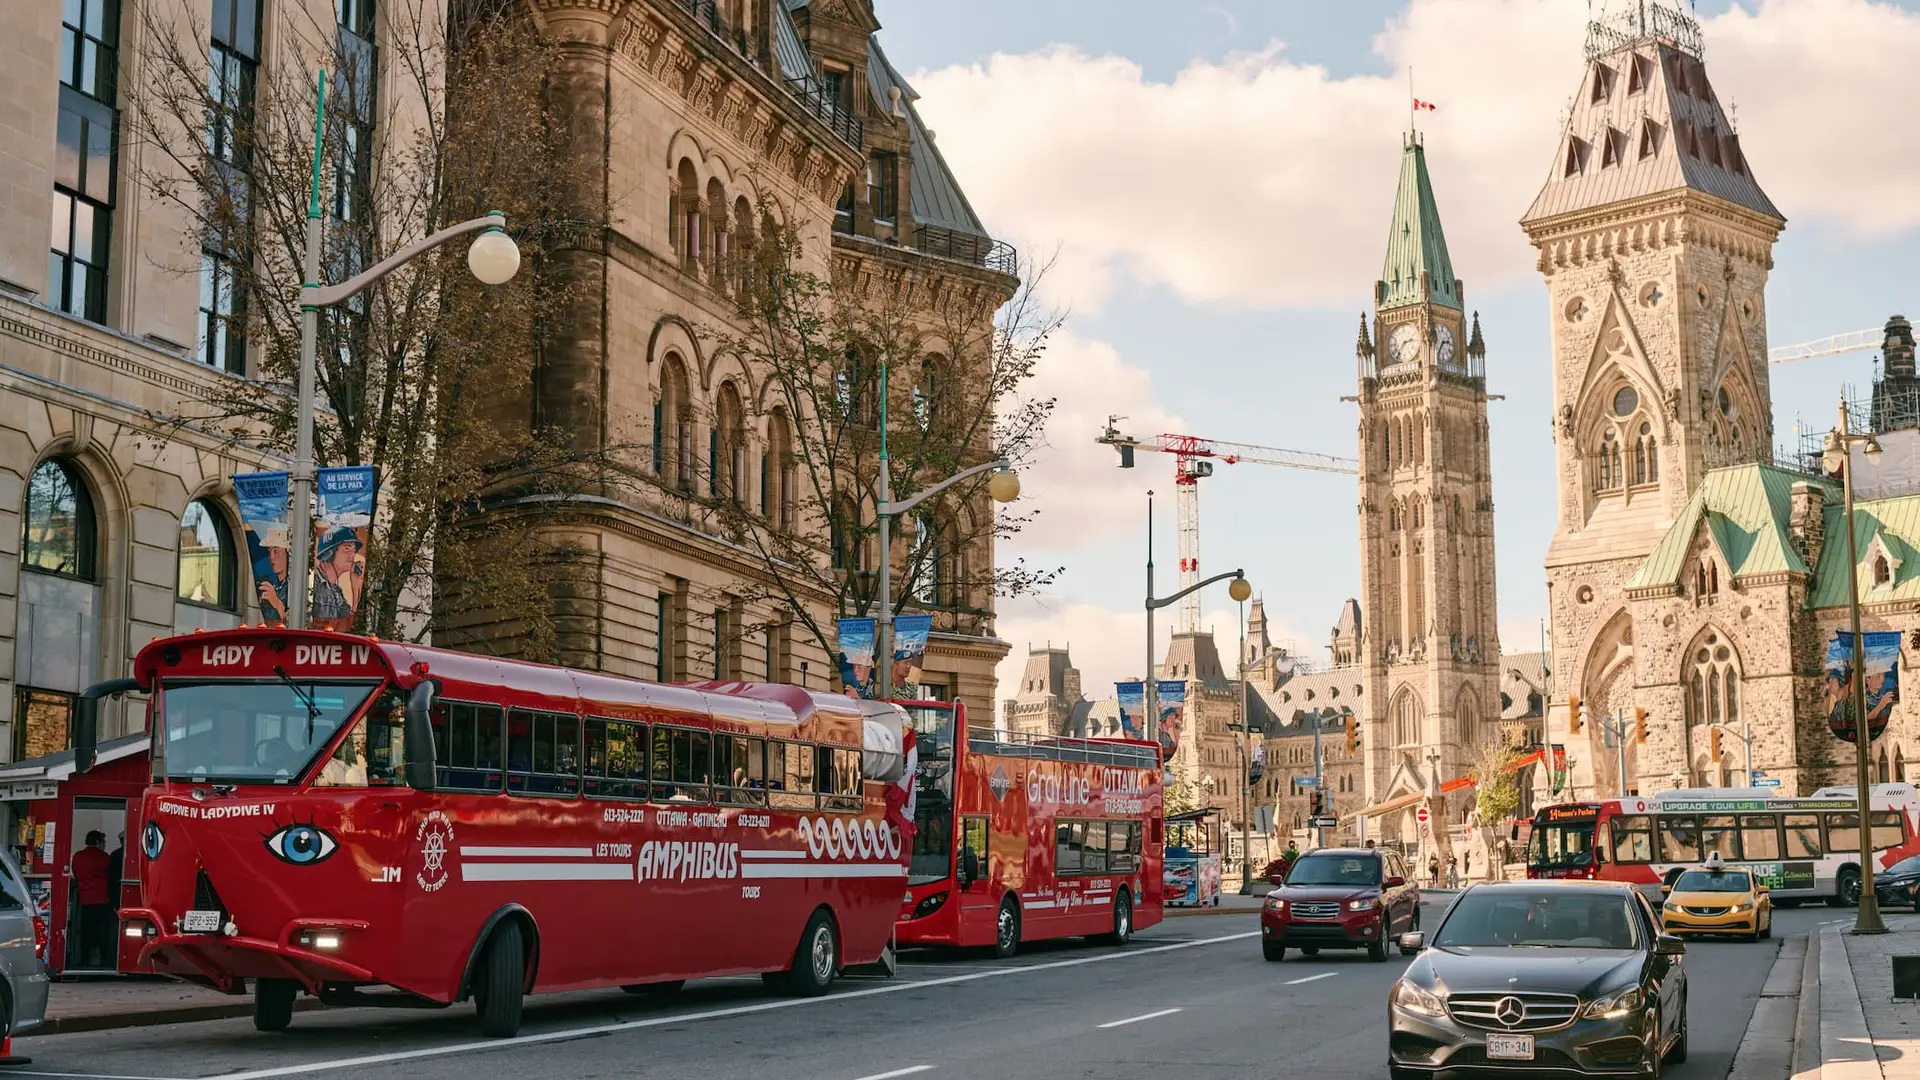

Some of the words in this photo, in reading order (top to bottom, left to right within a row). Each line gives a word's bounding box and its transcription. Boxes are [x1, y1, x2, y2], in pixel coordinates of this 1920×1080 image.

[327, 474, 336, 482] AU
[337, 473, 363, 481] SERVICE
[327, 482, 337, 490] DE
[339, 482, 347, 490] LA
[348, 481, 363, 489] PAIX
[202, 645, 254, 667] LADY
[295, 645, 342, 665] DIVE
[350, 645, 370, 665] IV
[1104, 768, 1143, 794] OTTAWA
[160, 801, 190, 818] LADYDIVE
[190, 807, 198, 818] IV
[201, 804, 260, 819] LADYDIVE
[263, 804, 275, 815] IV
[1549, 808, 1557, 820] 14
[1664, 802, 1708, 811] UPGRADE
[1709, 802, 1736, 810] YOUR
[1737, 802, 1758, 810] LIFE!
[416, 816, 429, 841] LAND
[428, 810, 441, 821] AND
[440, 812, 454, 841] WATER
[656, 811, 687, 827] OTTAWA
[693, 812, 727, 828] GATINEAU
[596, 843, 609, 857] LES
[610, 844, 632, 858] TOURS
[638, 841, 739, 884] AMPHIBUS
[416, 872, 427, 889] EAU
[425, 883, 433, 892] ET
[432, 871, 448, 892] TERRE
[742, 886, 761, 899] TOURS
